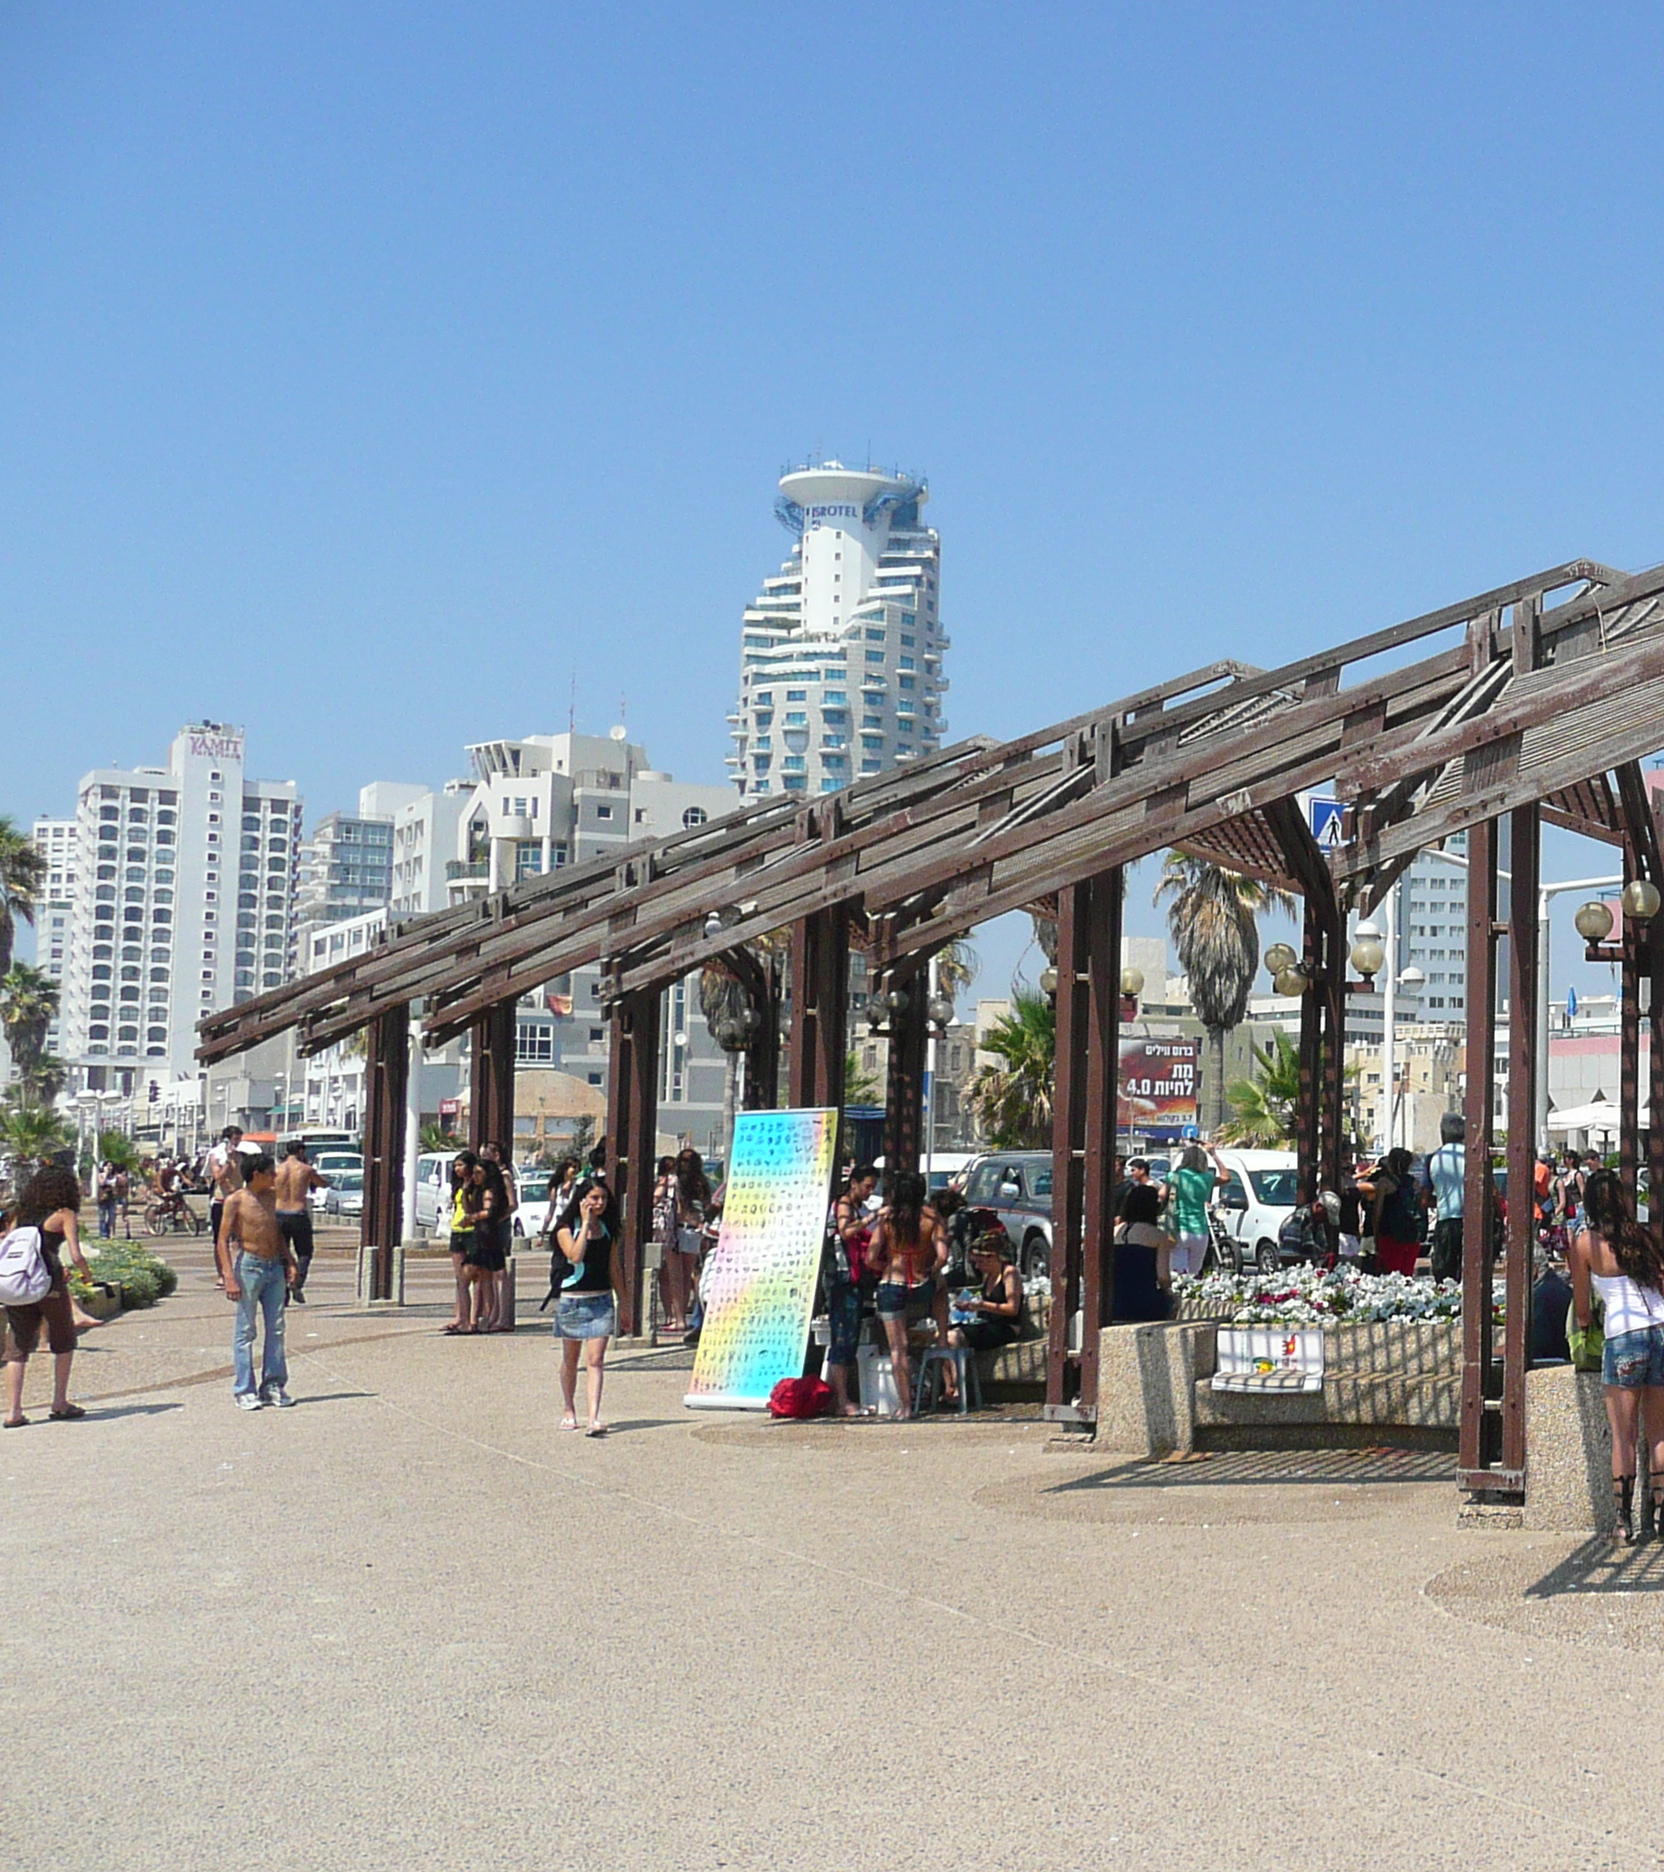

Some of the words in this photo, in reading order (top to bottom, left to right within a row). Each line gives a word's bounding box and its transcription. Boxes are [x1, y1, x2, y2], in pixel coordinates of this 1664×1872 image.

[189, 736, 241, 752] YAMIT
[1172, 1064, 1193, 1079] מת
[1127, 1079, 1151, 1095] 4.0
[1153, 1079, 1193, 1096] לחיות
